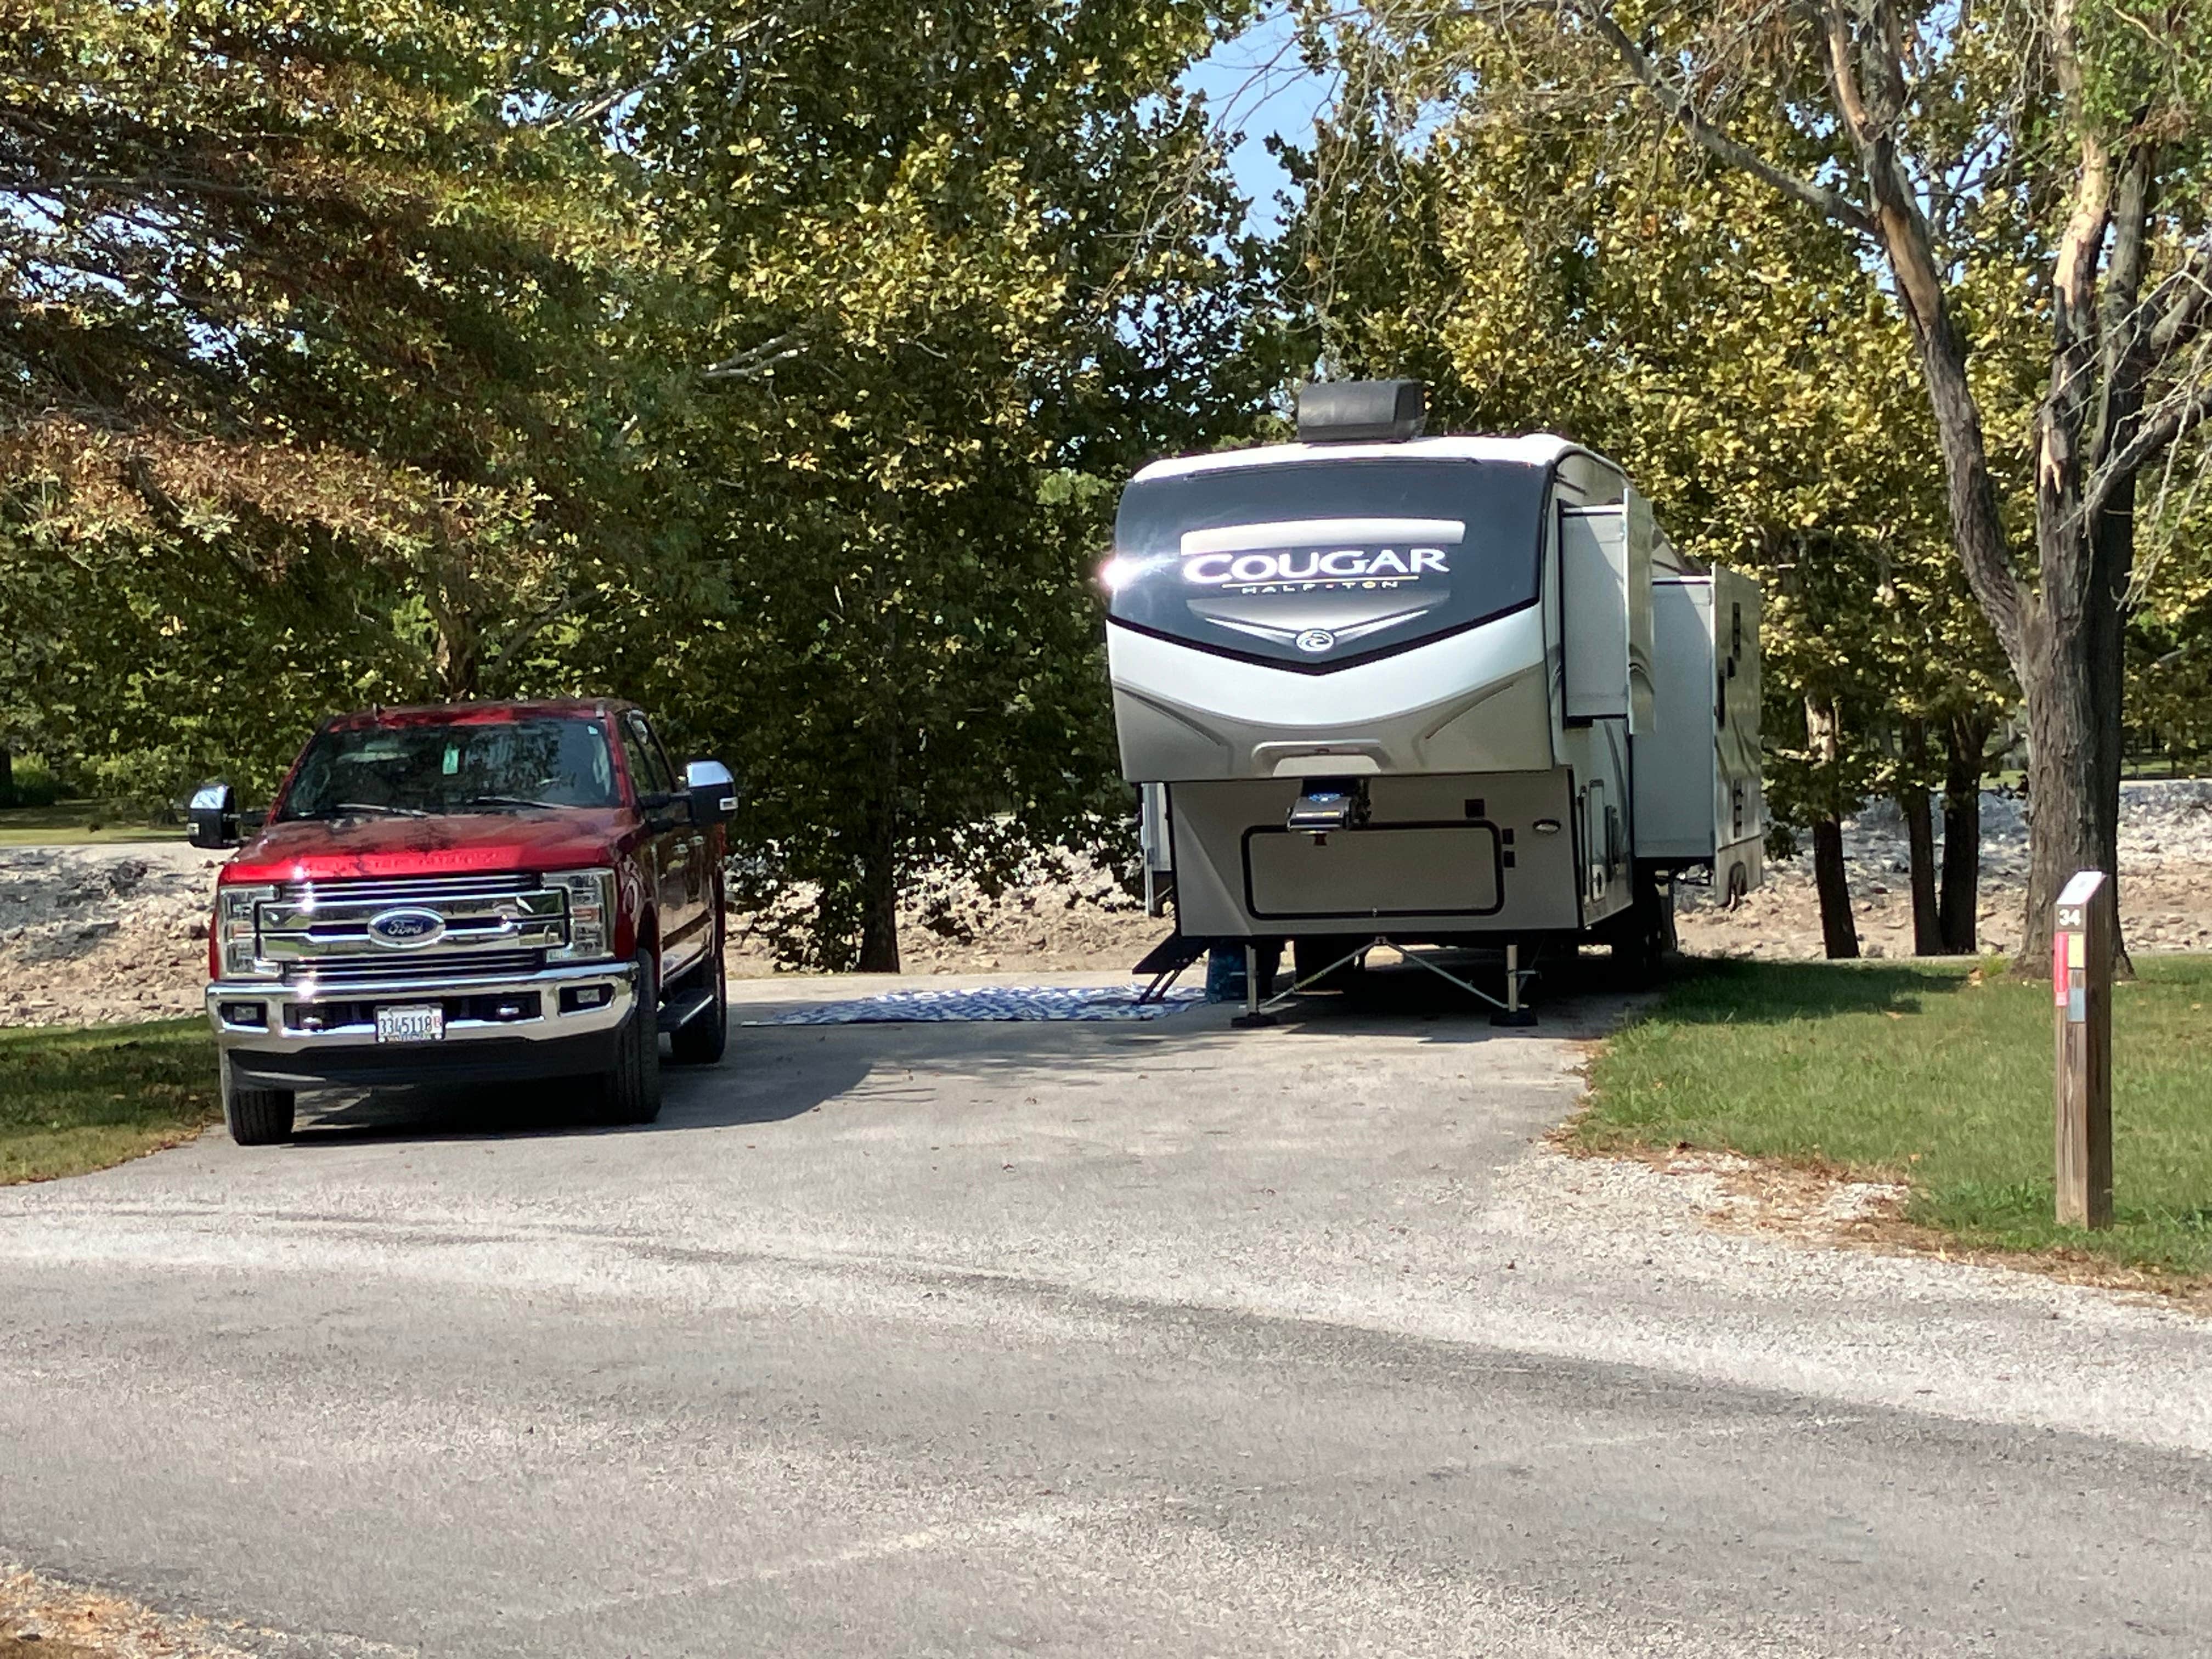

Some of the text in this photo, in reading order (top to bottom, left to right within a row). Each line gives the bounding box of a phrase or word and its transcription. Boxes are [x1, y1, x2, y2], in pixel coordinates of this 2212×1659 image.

[1182, 548, 1451, 584] COUGAR
[387, 919, 425, 935] Ford
[2058, 908, 2081, 927] 34
